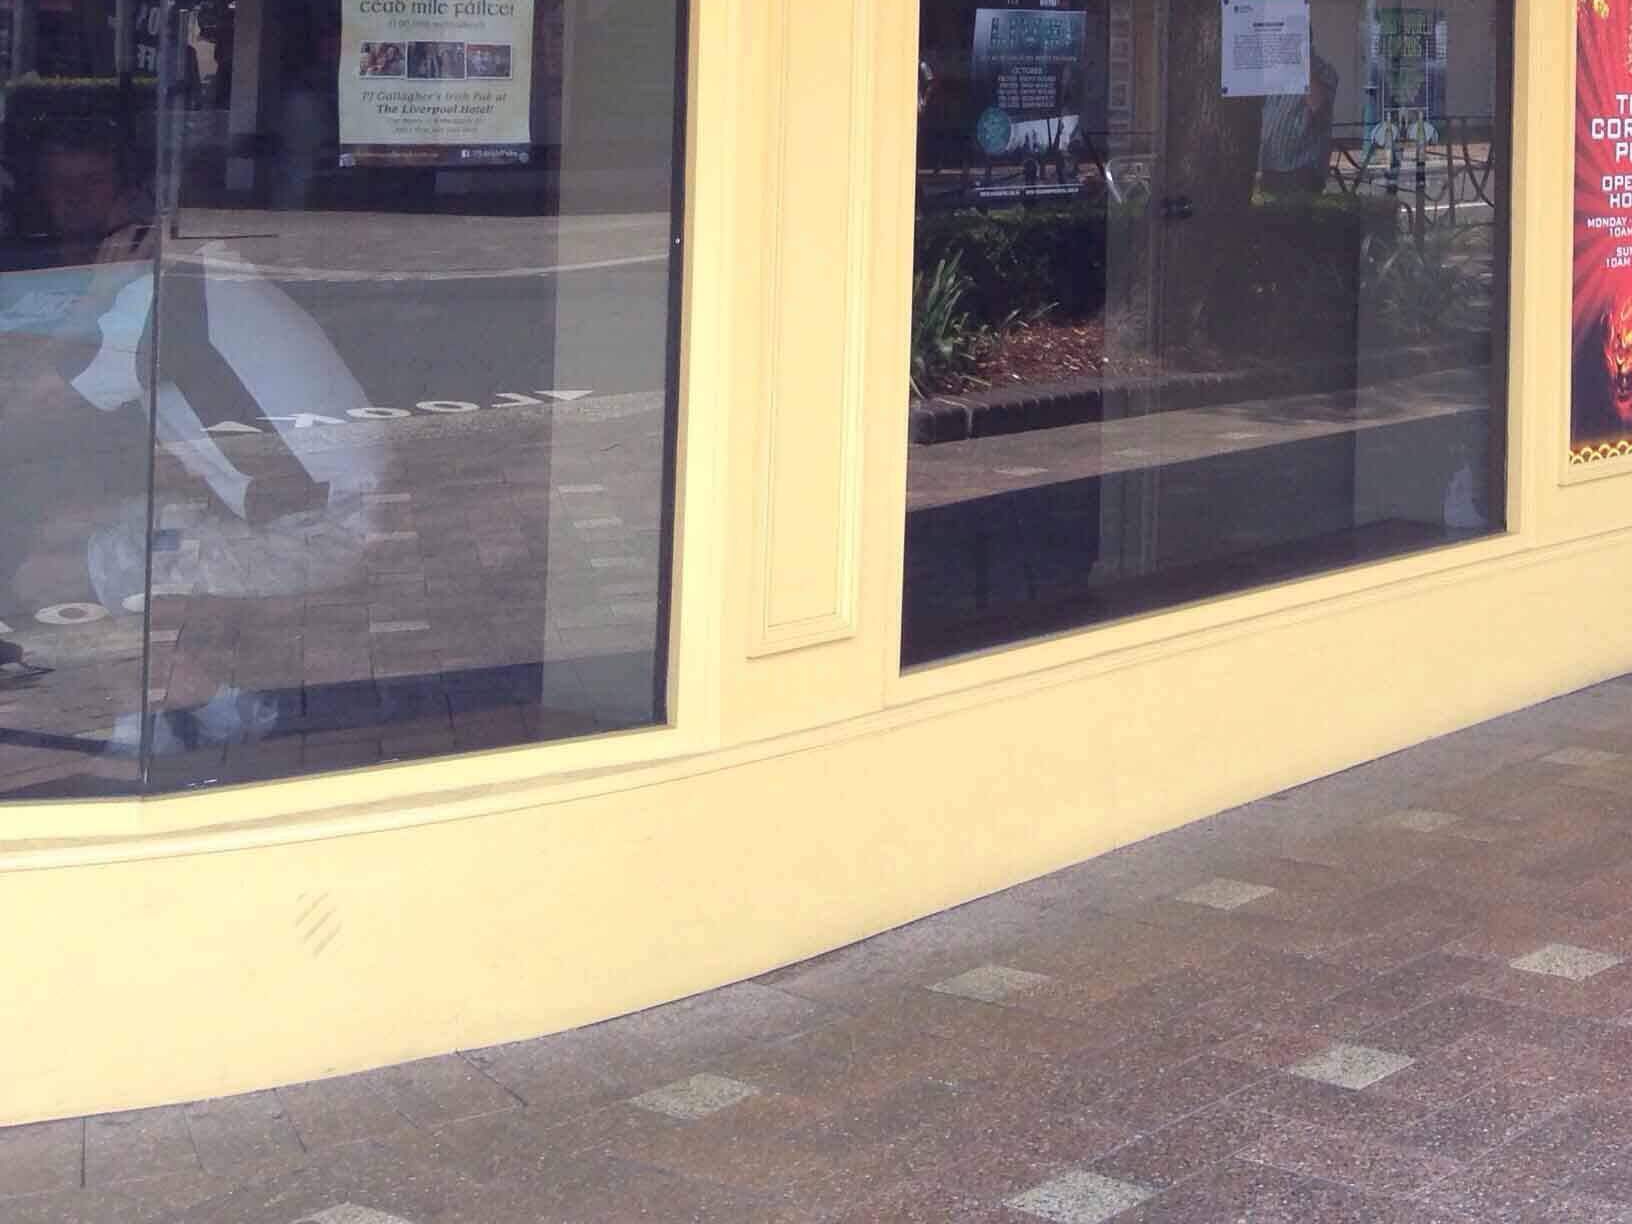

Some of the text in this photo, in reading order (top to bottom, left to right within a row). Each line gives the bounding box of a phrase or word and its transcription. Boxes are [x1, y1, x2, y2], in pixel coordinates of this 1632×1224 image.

[376, 104, 399, 114] The
[401, 104, 457, 116] Liverpool
[1587, 216, 1628, 228] MONDAY
[1606, 257, 1631, 267] 10AM
